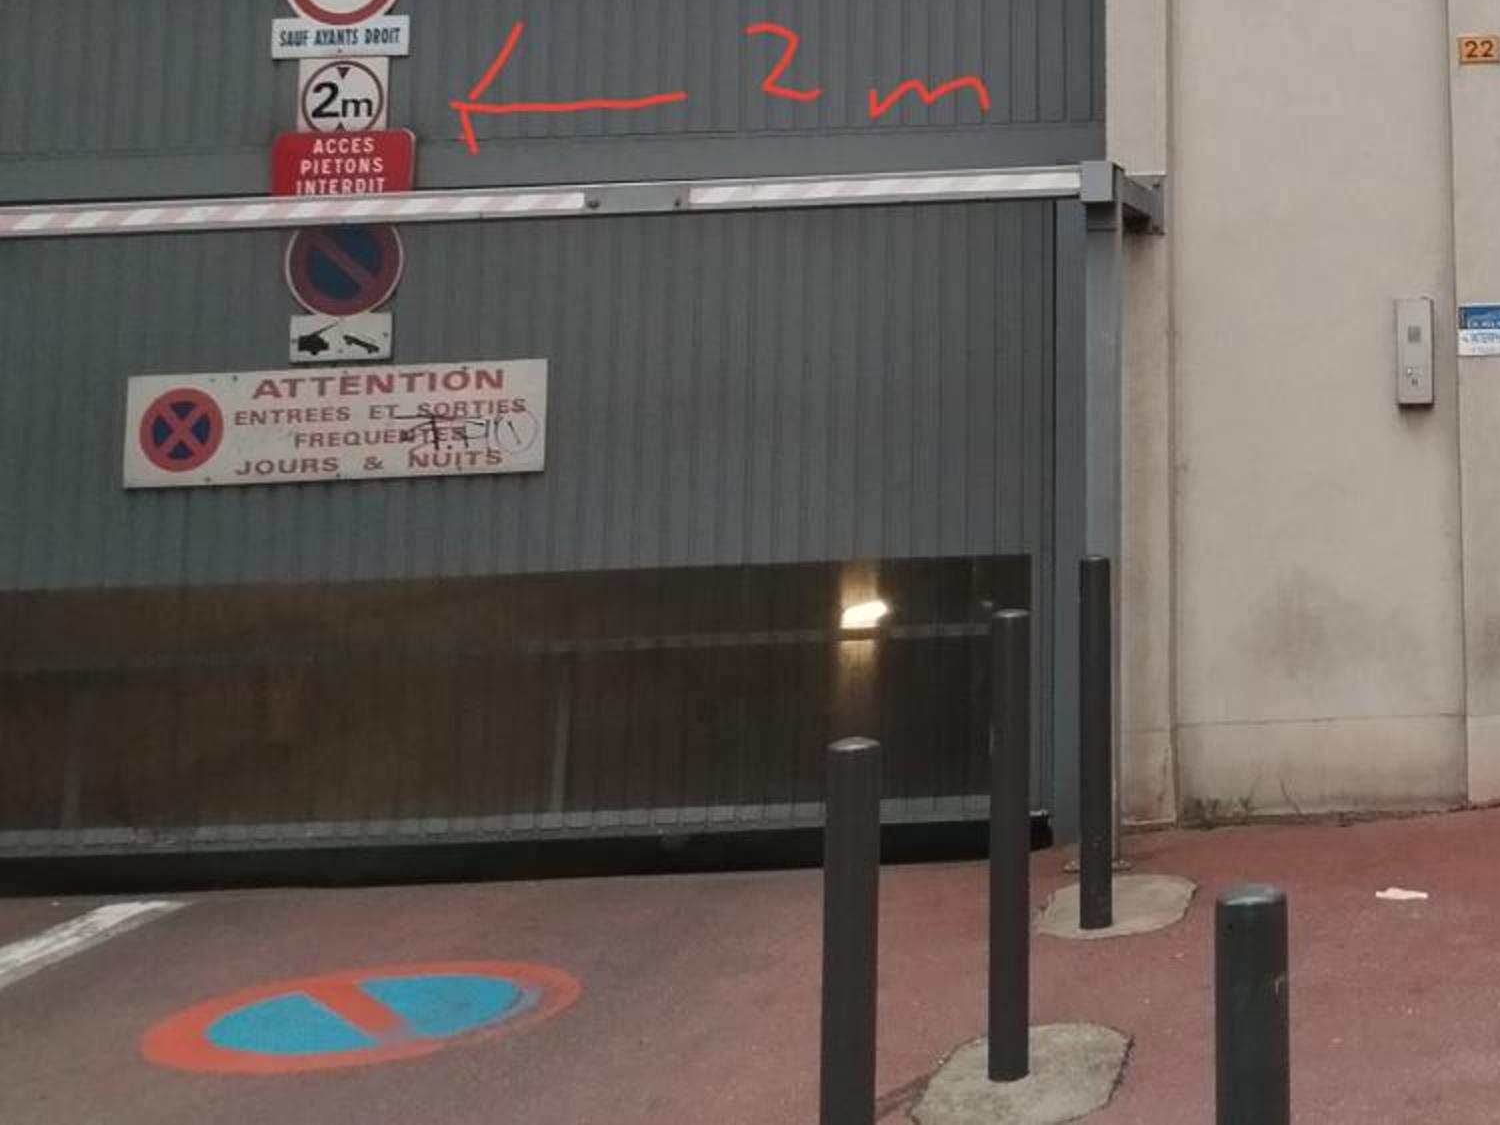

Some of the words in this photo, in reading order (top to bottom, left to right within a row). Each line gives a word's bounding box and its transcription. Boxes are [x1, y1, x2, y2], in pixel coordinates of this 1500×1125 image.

[280, 30, 309, 46] SAUF
[314, 27, 359, 45] AYANTS
[365, 26, 401, 44] DROIT
[1464, 40, 1493, 57] 22
[312, 82, 373, 118] 2m
[313, 137, 375, 154] ACCES
[300, 156, 384, 175] PIETONS
[295, 177, 385, 194] INTERDIT
[252, 369, 504, 400] ATTENTION
[234, 406, 350, 426] ENTREES
[369, 404, 399, 420] ET
[417, 398, 527, 419] SORTIES
[294, 425, 466, 450] FREQUENTES
[236, 456, 339, 476] JOURS
[362, 455, 383, 471] &
[409, 448, 503, 468] NUITS
